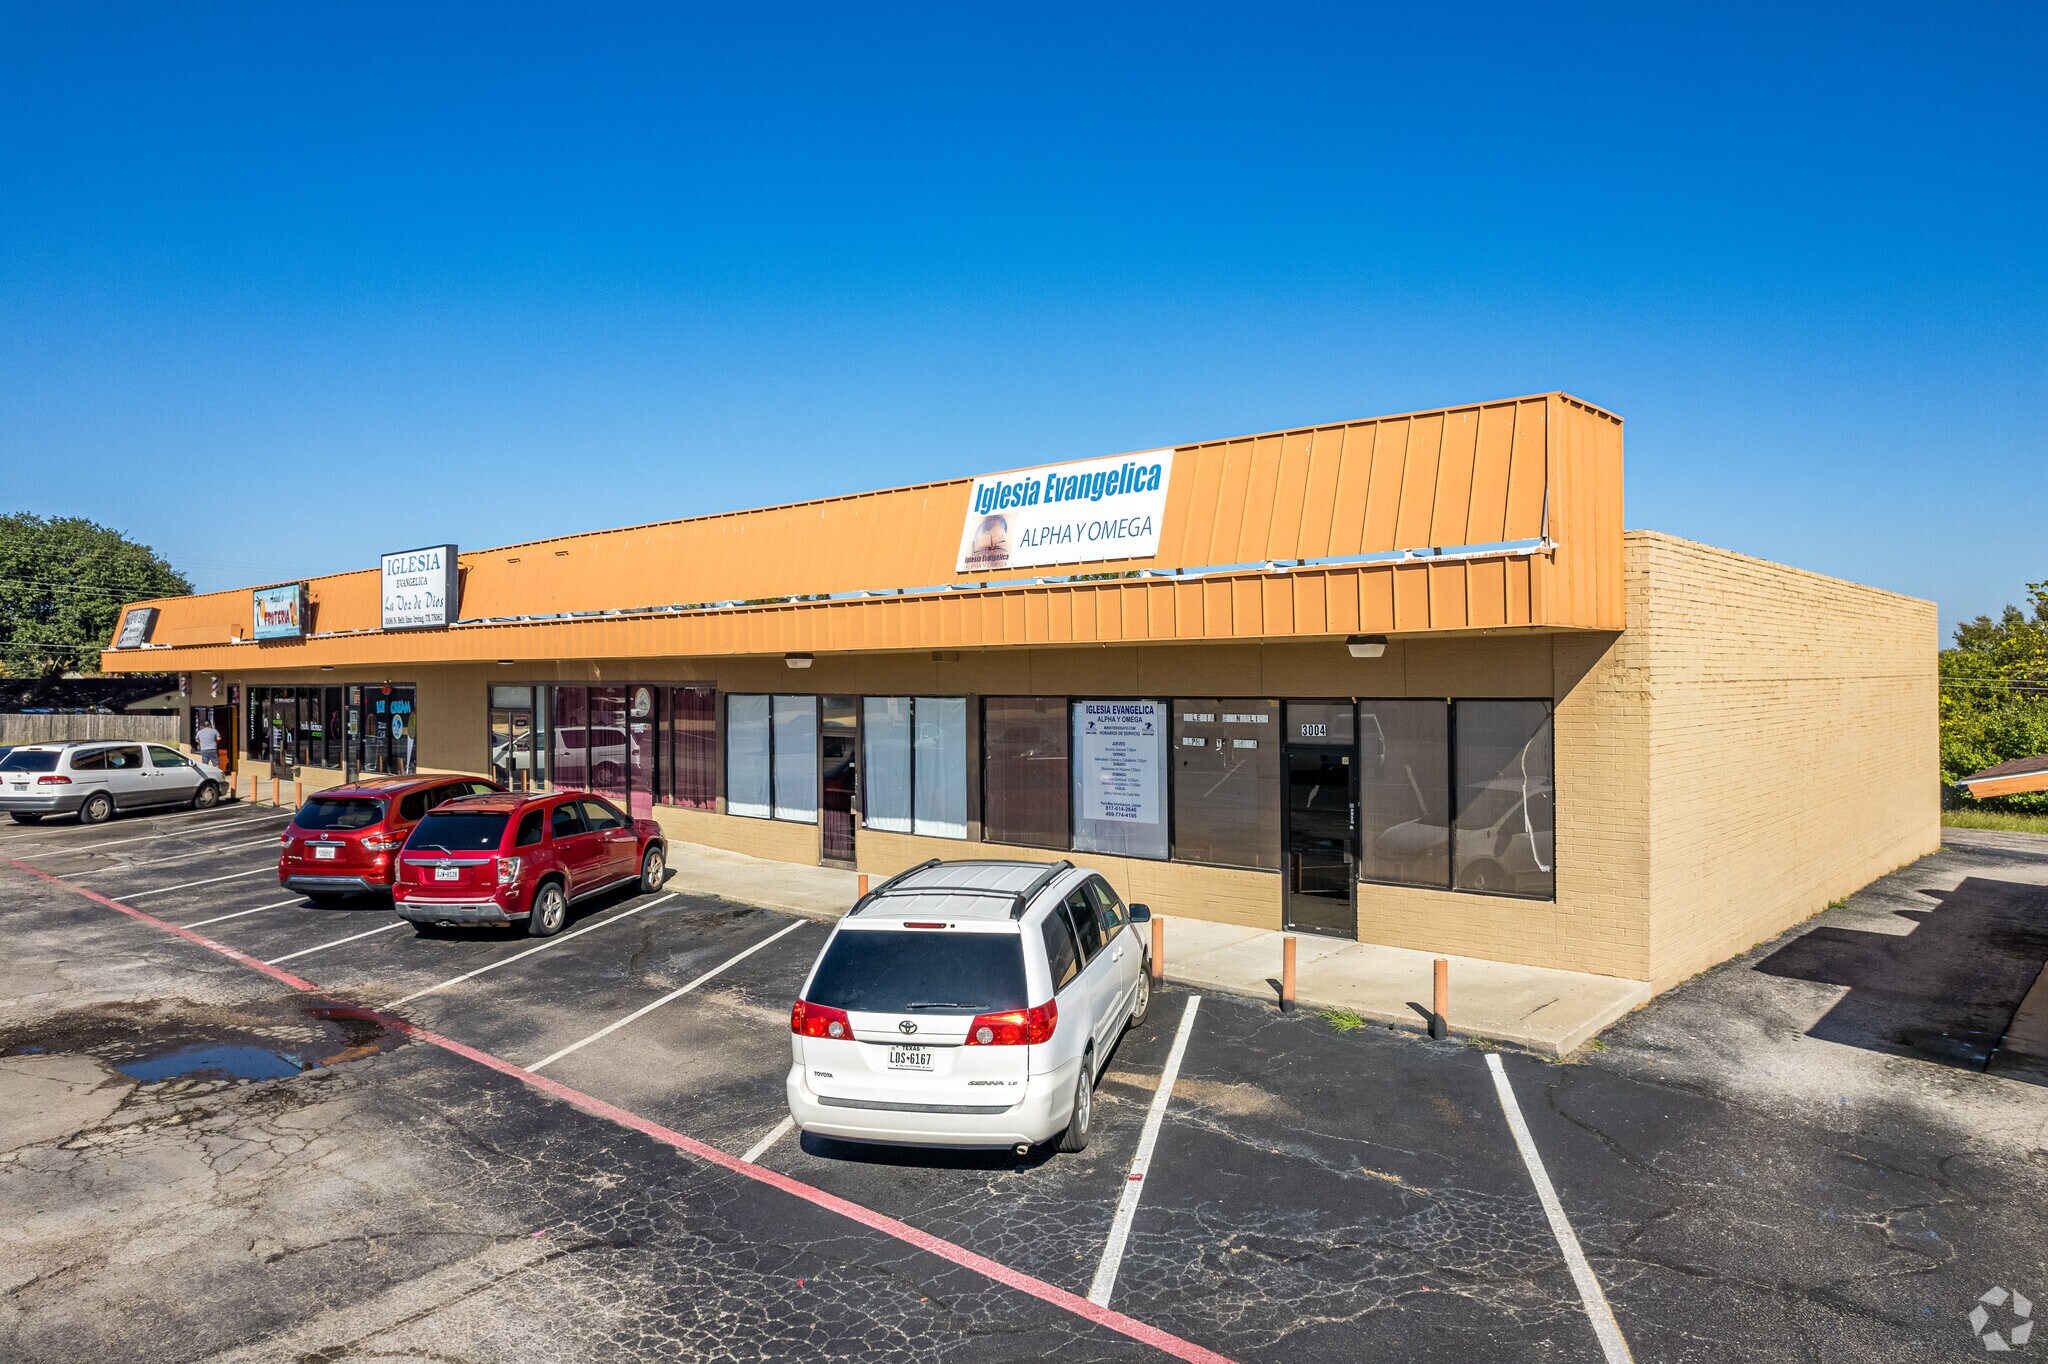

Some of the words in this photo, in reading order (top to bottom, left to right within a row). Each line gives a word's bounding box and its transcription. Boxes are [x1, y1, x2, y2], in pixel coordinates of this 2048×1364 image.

[974, 477, 1041, 515] Iglesia
[1043, 462, 1162, 504] Evangelica
[1020, 524, 1072, 548] ALPHA
[1074, 523, 1087, 543] Y
[1087, 516, 1152, 542] OMEGA
[387, 552, 441, 576] IGLESIA
[982, 554, 1009, 562] Evangelica
[397, 577, 428, 588] EVANGELICA
[425, 591, 444, 608] Dios
[390, 700, 411, 714] CREAM
[1086, 705, 1111, 715] IGLESIA
[1112, 705, 1154, 715] EVANGELICA
[1302, 725, 1326, 736] 3004
[814, 1070, 834, 1078] TOYOTA
